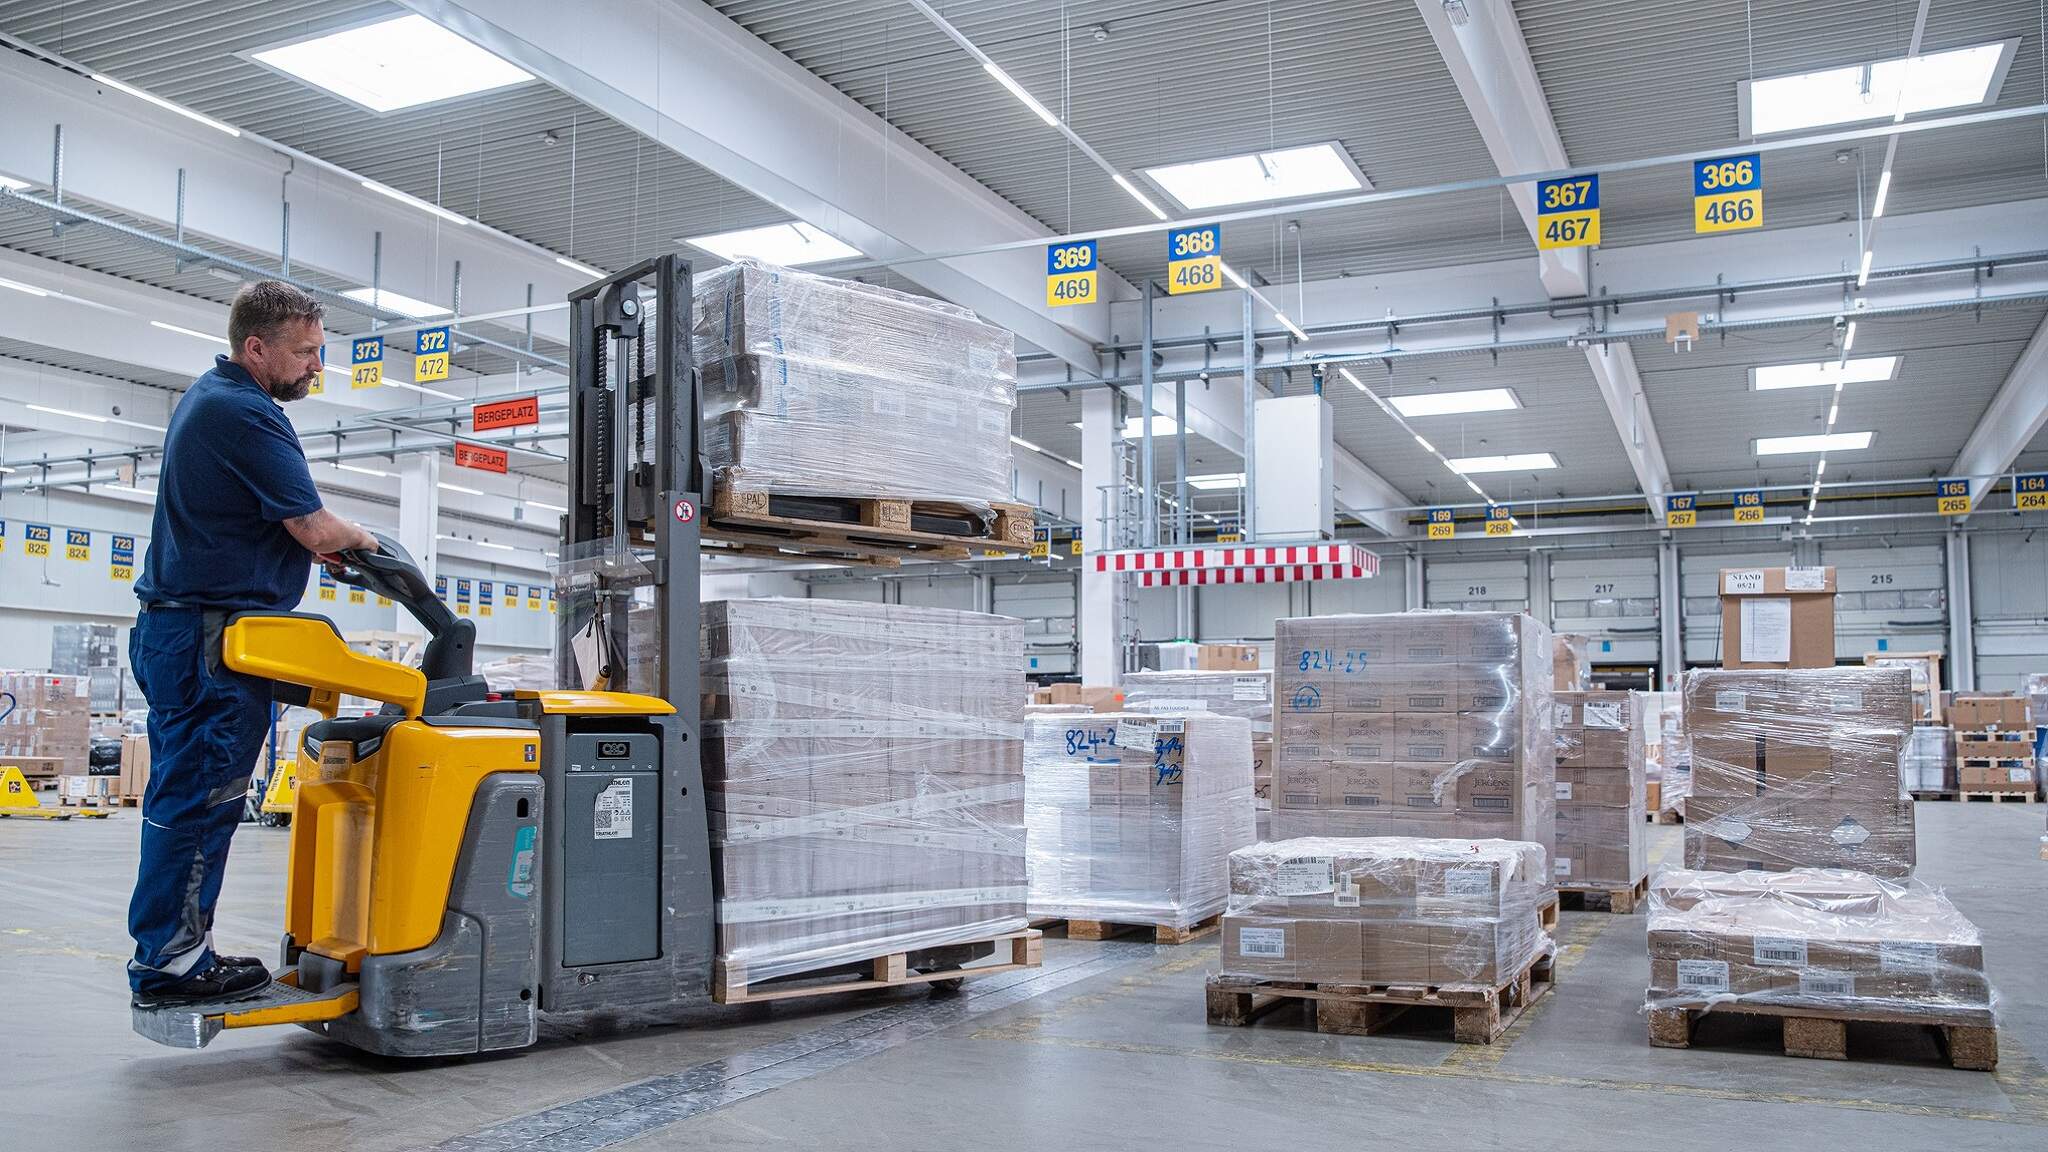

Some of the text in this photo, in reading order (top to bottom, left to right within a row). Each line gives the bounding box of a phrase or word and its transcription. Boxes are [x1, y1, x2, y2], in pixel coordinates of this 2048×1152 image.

[1702, 160, 1753, 190] 366
[1544, 180, 1591, 208] 367
[1704, 198, 1753, 225] 466
[1545, 217, 1591, 242] 467
[1175, 230, 1214, 256] 368
[1054, 245, 1091, 270] 369
[1176, 263, 1214, 286] 468
[1054, 278, 1090, 300] 469
[420, 331, 446, 351] 372
[355, 341, 379, 360] 373
[420, 358, 444, 376] 472
[355, 367, 378, 384] 473
[477, 405, 534, 424] BERGEPLATZ
[1942, 482, 1966, 495] 165
[2020, 478, 2046, 491] 164
[1671, 497, 1692, 509] 167
[1737, 493, 1759, 505] 166
[1943, 499, 1967, 512] 265
[2021, 494, 2047, 507] 264
[1432, 510, 1451, 522] 169
[1489, 507, 1509, 519] 168
[1671, 513, 1691, 524] 267
[1738, 510, 1760, 521] 266
[29, 526, 49, 540] 725
[1432, 525, 1451, 536] 269
[1489, 523, 1508, 534] 268
[70, 531, 88, 545] 724
[1035, 530, 1047, 541] 73
[28, 542, 47, 556] 825
[114, 537, 132, 550] 723
[69, 547, 87, 559] 824
[113, 553, 133, 564] Direkt
[113, 566, 130, 579] 823
[1732, 573, 1761, 581] STAND
[1871, 574, 1893, 584] 215
[1468, 586, 1486, 595] 218
[1594, 584, 1614, 594] 217
[1737, 581, 1756, 590] 05/21
[1066, 727, 1116, 756] 824-2
[1472, 777, 1510, 788] JERGENS
